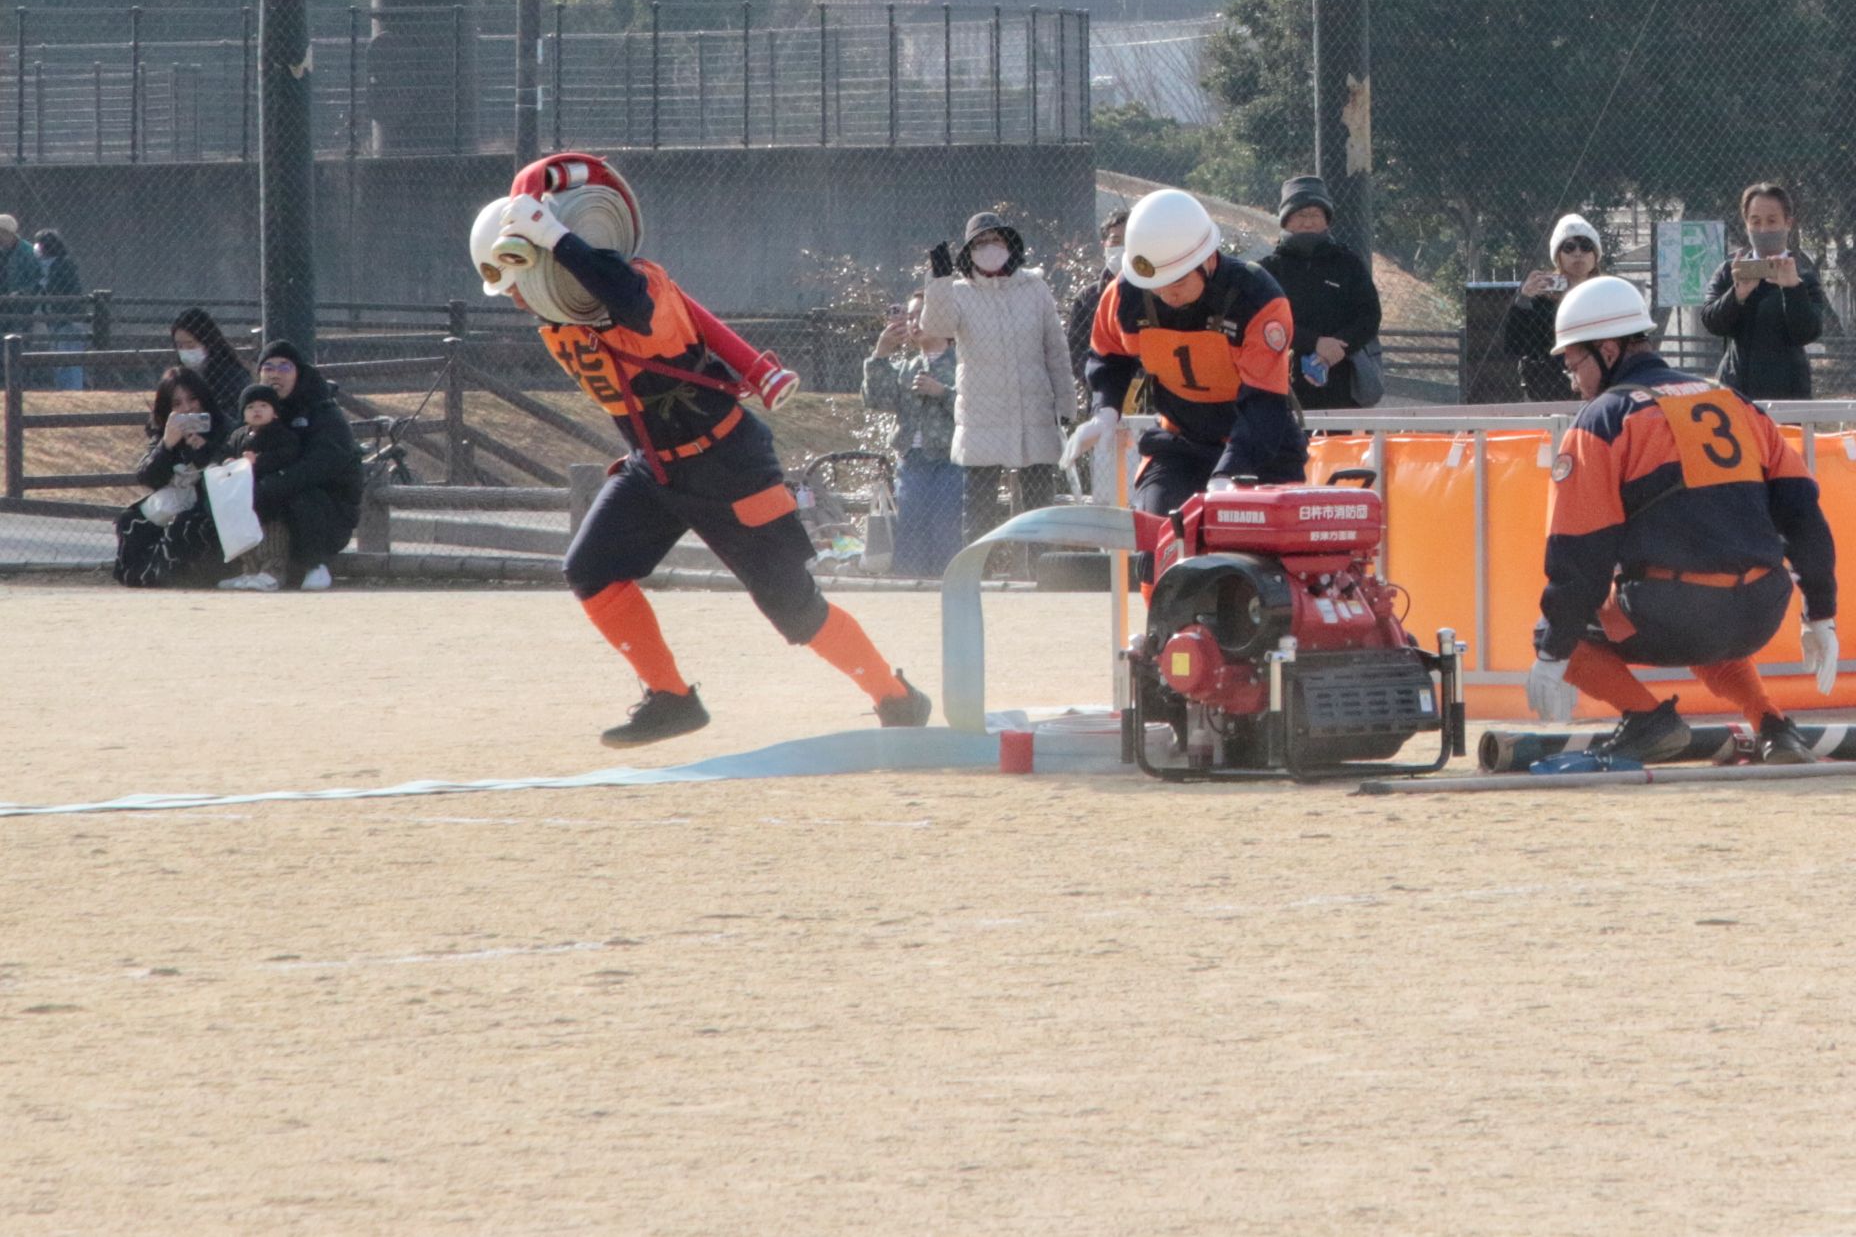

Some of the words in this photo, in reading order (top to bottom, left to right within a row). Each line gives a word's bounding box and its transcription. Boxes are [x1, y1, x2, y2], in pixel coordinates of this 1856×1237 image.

[1172, 344, 1211, 392] 1
[1691, 402, 1742, 469] 3
[1217, 510, 1266, 524] SHIBAURA
[1299, 504, 1369, 521] 臼杵市消防団
